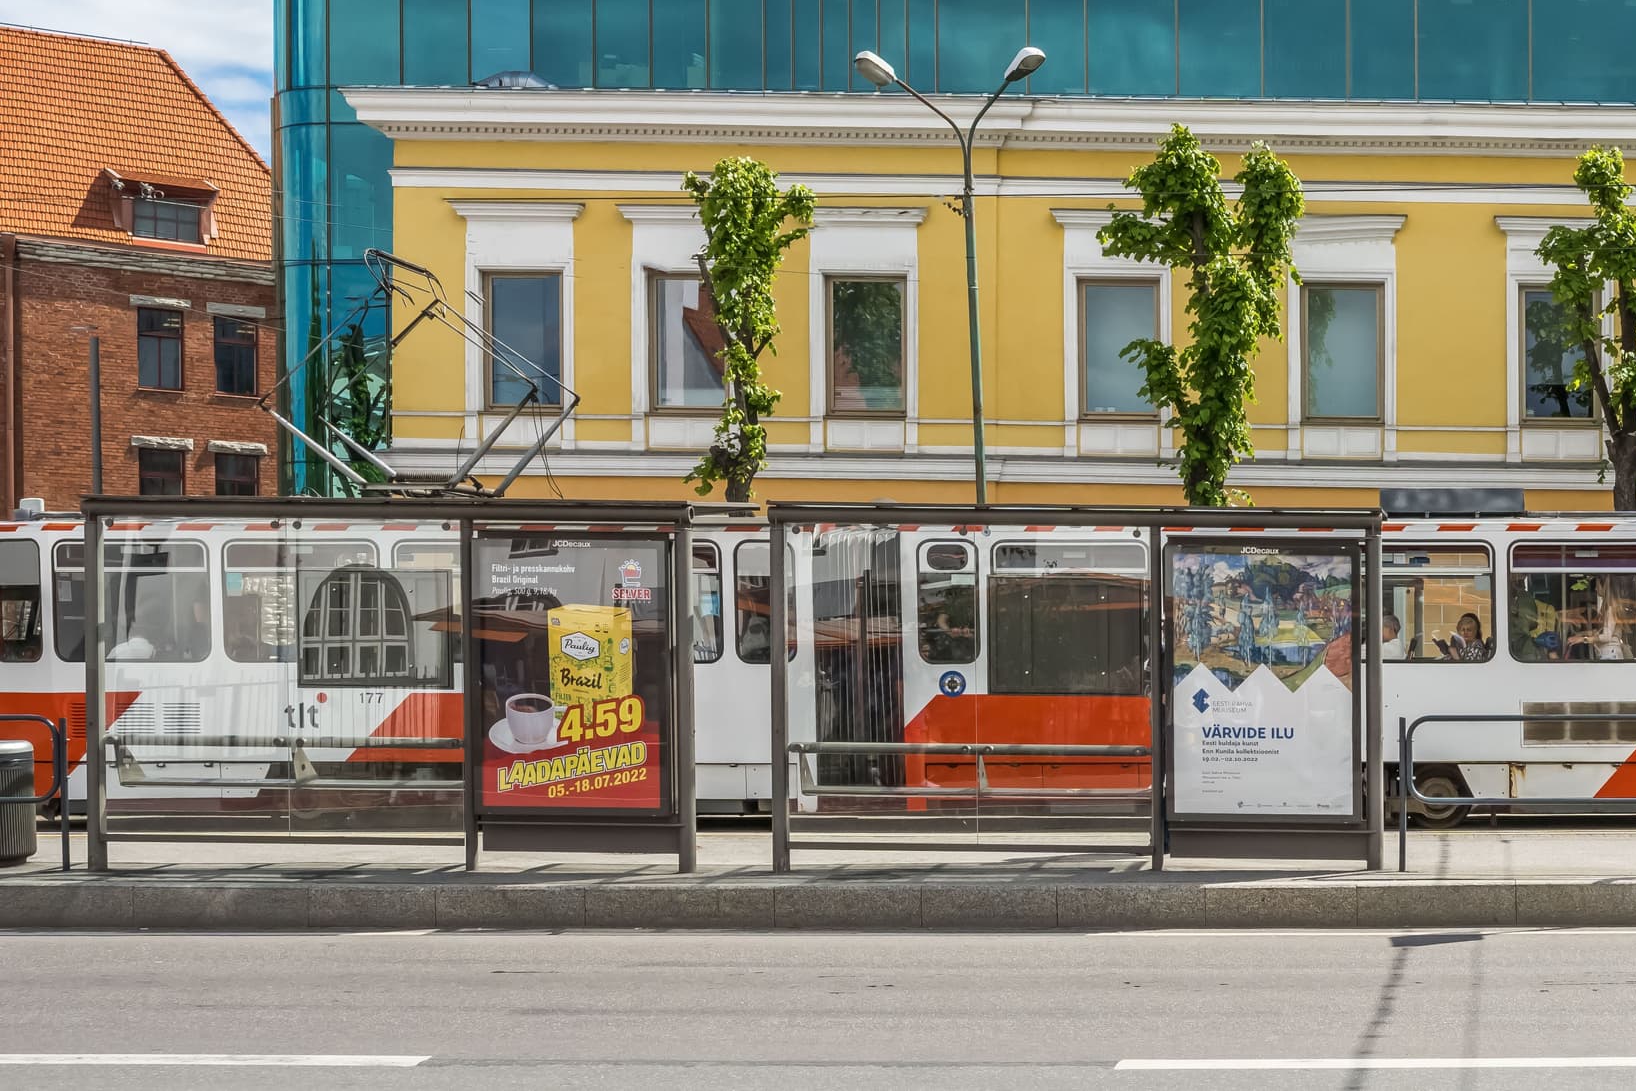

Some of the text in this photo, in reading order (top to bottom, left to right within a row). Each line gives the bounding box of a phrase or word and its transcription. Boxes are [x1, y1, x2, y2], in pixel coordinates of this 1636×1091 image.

[552, 540, 591, 548] JCDecaux
[1240, 546, 1280, 554] JCDecaux
[491, 563, 511, 573] Filtri-
[512, 564, 520, 574] ja
[491, 575, 538, 585] Brazil Original
[612, 587, 651, 599] SELVER
[564, 639, 595, 654] Paulig
[560, 667, 602, 689] Brazil
[359, 692, 383, 704] 177
[283, 702, 319, 729] tlt
[559, 697, 642, 742] 4.59
[1201, 724, 1295, 739] VÄRVIDE ILU
[498, 741, 648, 793] LAADAPÄEVAD
[547, 767, 647, 799] 05.-18.07.2022
